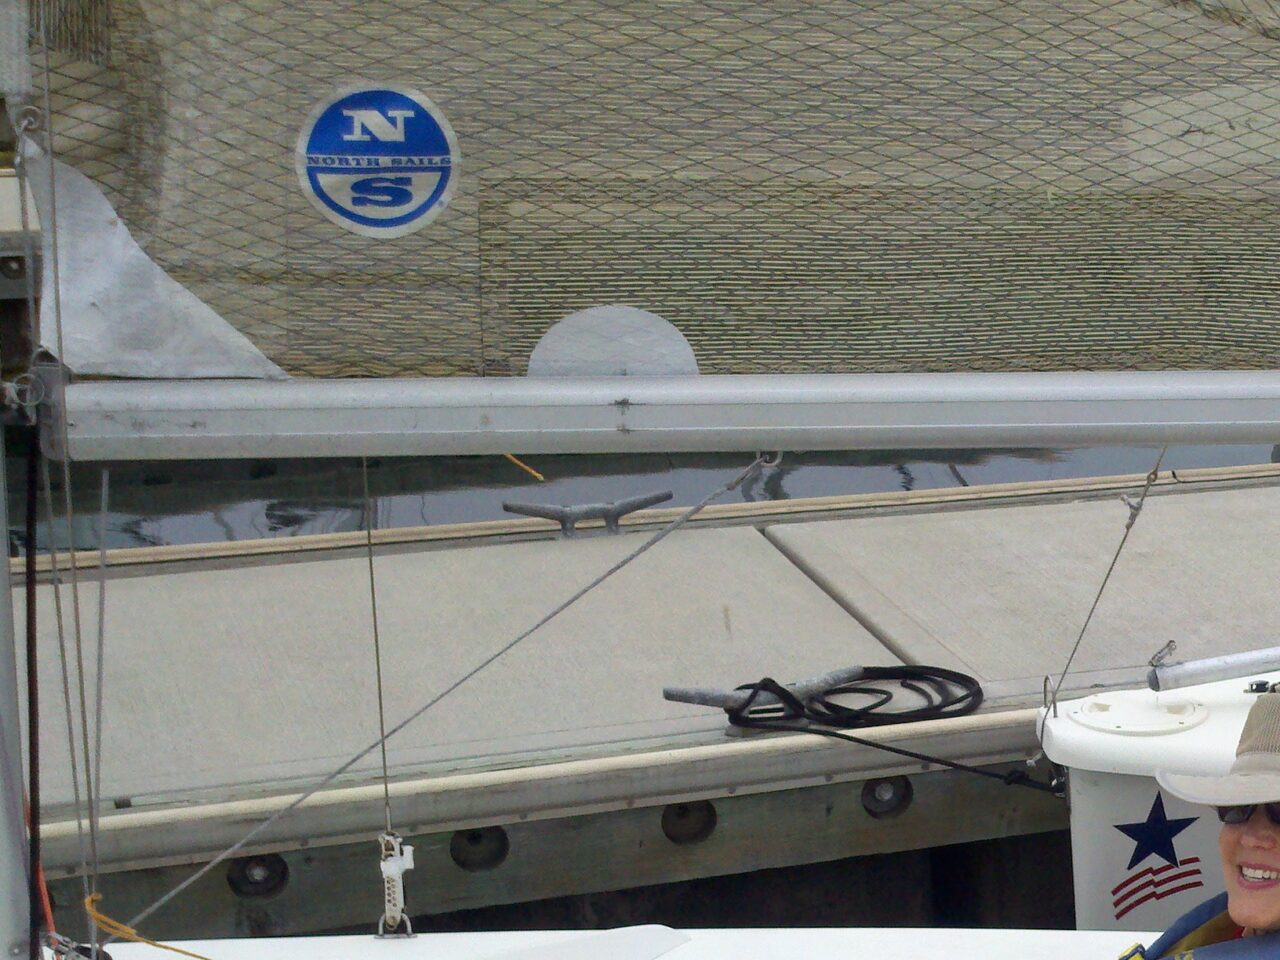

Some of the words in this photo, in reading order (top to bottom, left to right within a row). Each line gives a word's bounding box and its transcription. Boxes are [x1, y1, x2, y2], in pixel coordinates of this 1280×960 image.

[342, 110, 415, 142] N
[307, 156, 381, 167] NORTH
[390, 157, 452, 167] SAILS
[351, 176, 414, 208] S
